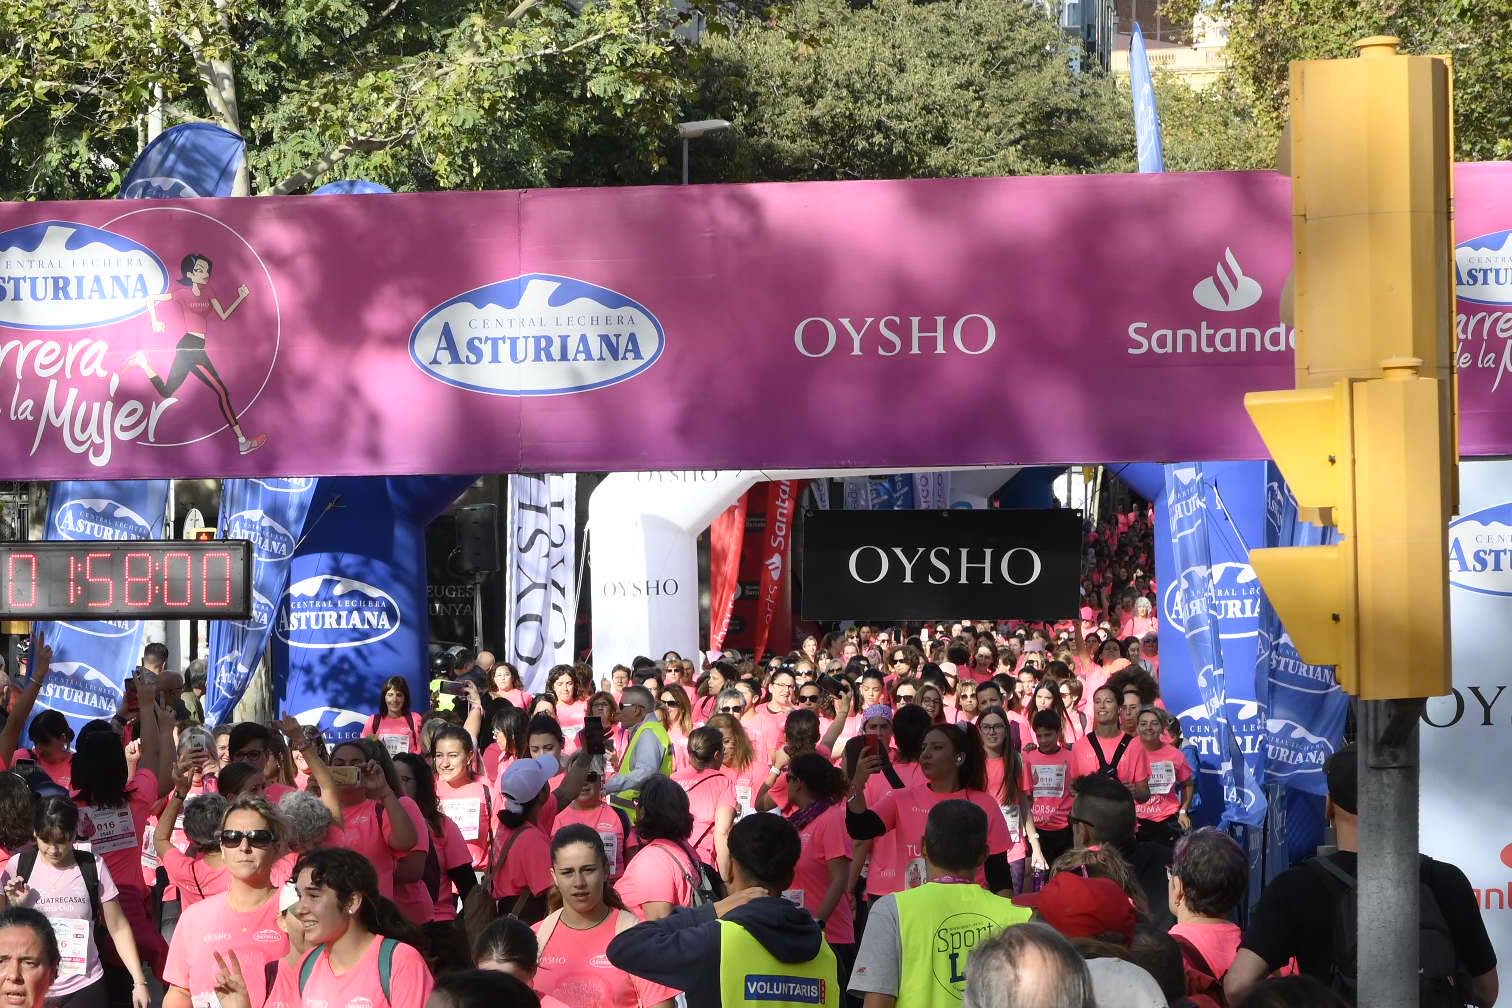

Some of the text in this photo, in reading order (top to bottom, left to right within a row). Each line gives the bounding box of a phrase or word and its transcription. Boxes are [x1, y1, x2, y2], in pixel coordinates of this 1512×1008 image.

[468, 314, 636, 330] CENTRAL LECHERA
[794, 314, 996, 358] OYSHO
[428, 321, 644, 366] ASTURIANA
[1477, 340, 1496, 369] la
[10, 381, 35, 421] la
[29, 373, 179, 467] Mujer
[847, 545, 1042, 586] OYSHO
[8, 553, 231, 608] 01:58:00
[602, 578, 679, 598] OYSHO
[291, 599, 387, 609] CENTRAL LECHERA
[278, 609, 391, 632] ASTURIANA
[96, 820, 116, 831] 016
[937, 922, 994, 955] Sport
[747, 979, 819, 997] VOLUNTARIS
